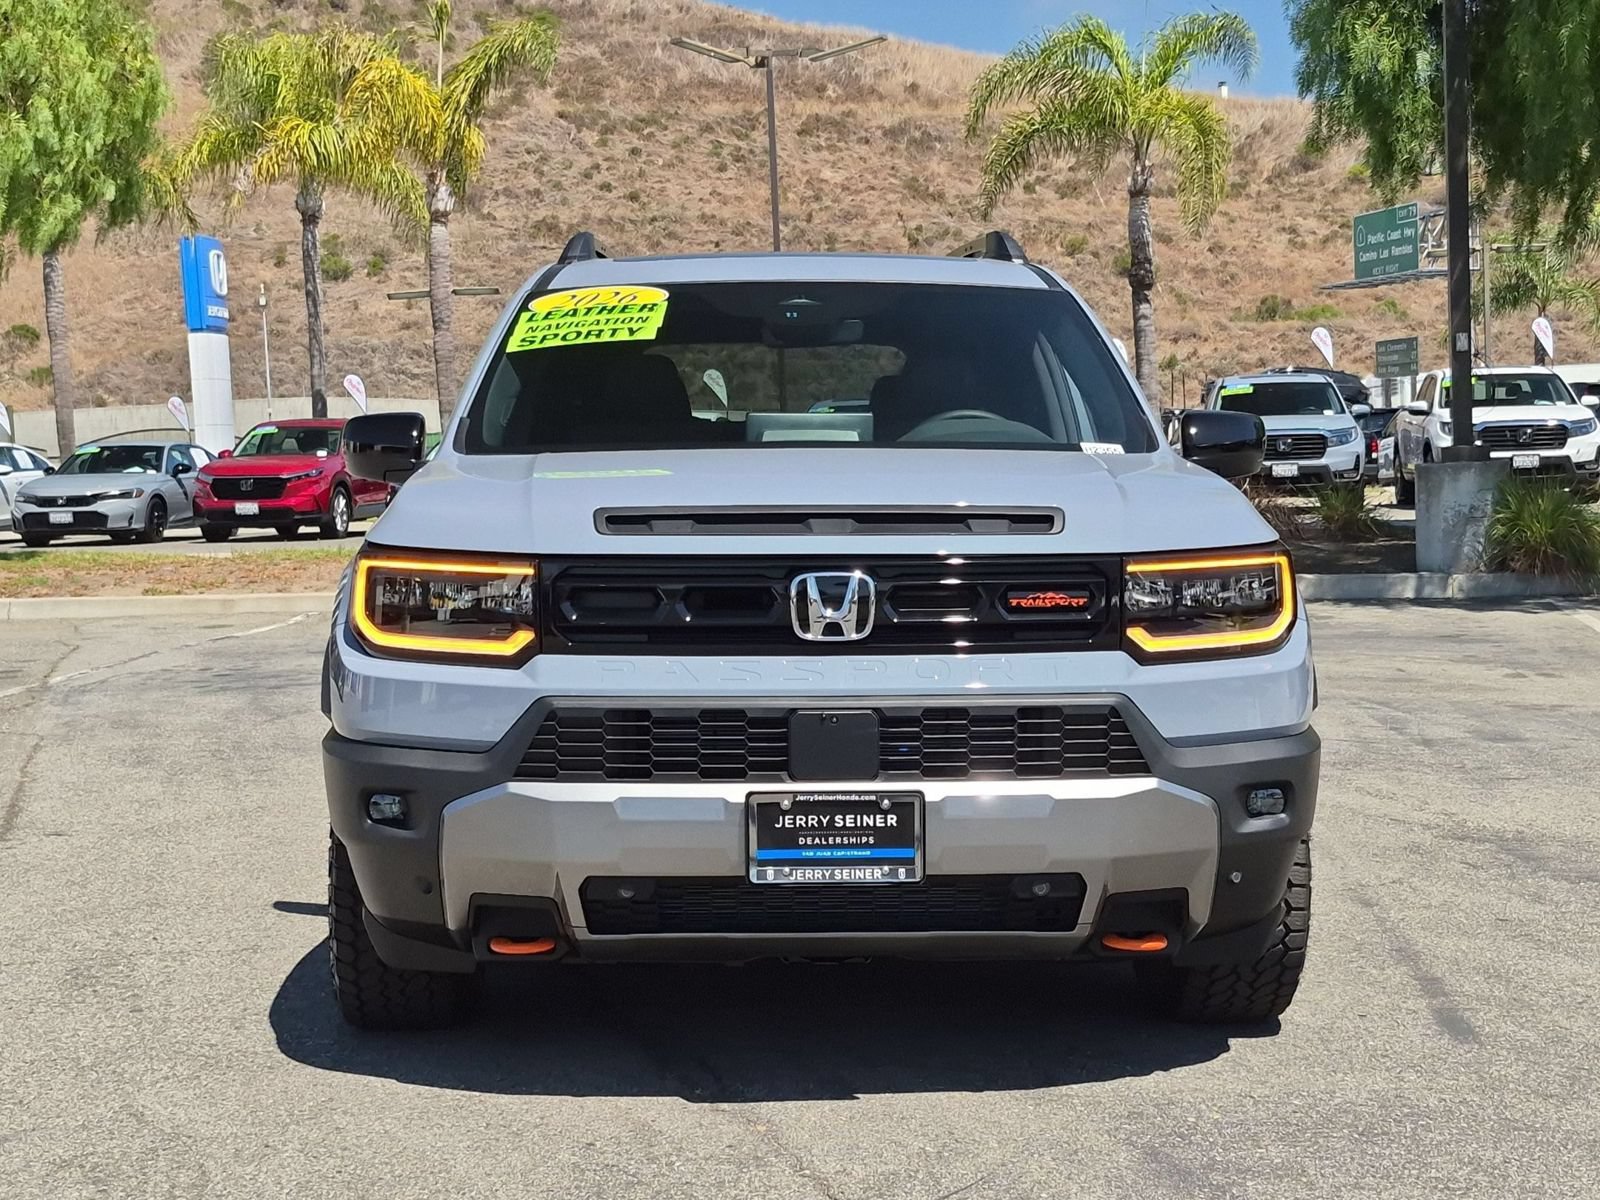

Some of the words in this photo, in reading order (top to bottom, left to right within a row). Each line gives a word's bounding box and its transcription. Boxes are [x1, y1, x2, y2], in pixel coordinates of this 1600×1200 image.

[1409, 205, 1416, 215] 79
[1367, 232, 1384, 244] Pacific
[1387, 229, 1401, 240] Coast
[1404, 226, 1416, 239] Hwy
[1360, 250, 1377, 262] Camino
[1386, 264, 1399, 272] RIGHT
[551, 291, 638, 309] 2026
[526, 303, 658, 322] LEATHER
[525, 316, 650, 334] NAVIGATION
[517, 326, 644, 348] SPORTY
[1010, 598, 1087, 608] TRAILSPORT
[594, 658, 1069, 682] PASSPORT
[796, 794, 876, 802] JerrySeinerHonda.com
[774, 815, 830, 828] JERRY
[834, 814, 897, 827] SEINER
[798, 836, 874, 844] DEALERSHIPS
[790, 870, 832, 880] JERRY
[834, 869, 882, 880] SEINER
